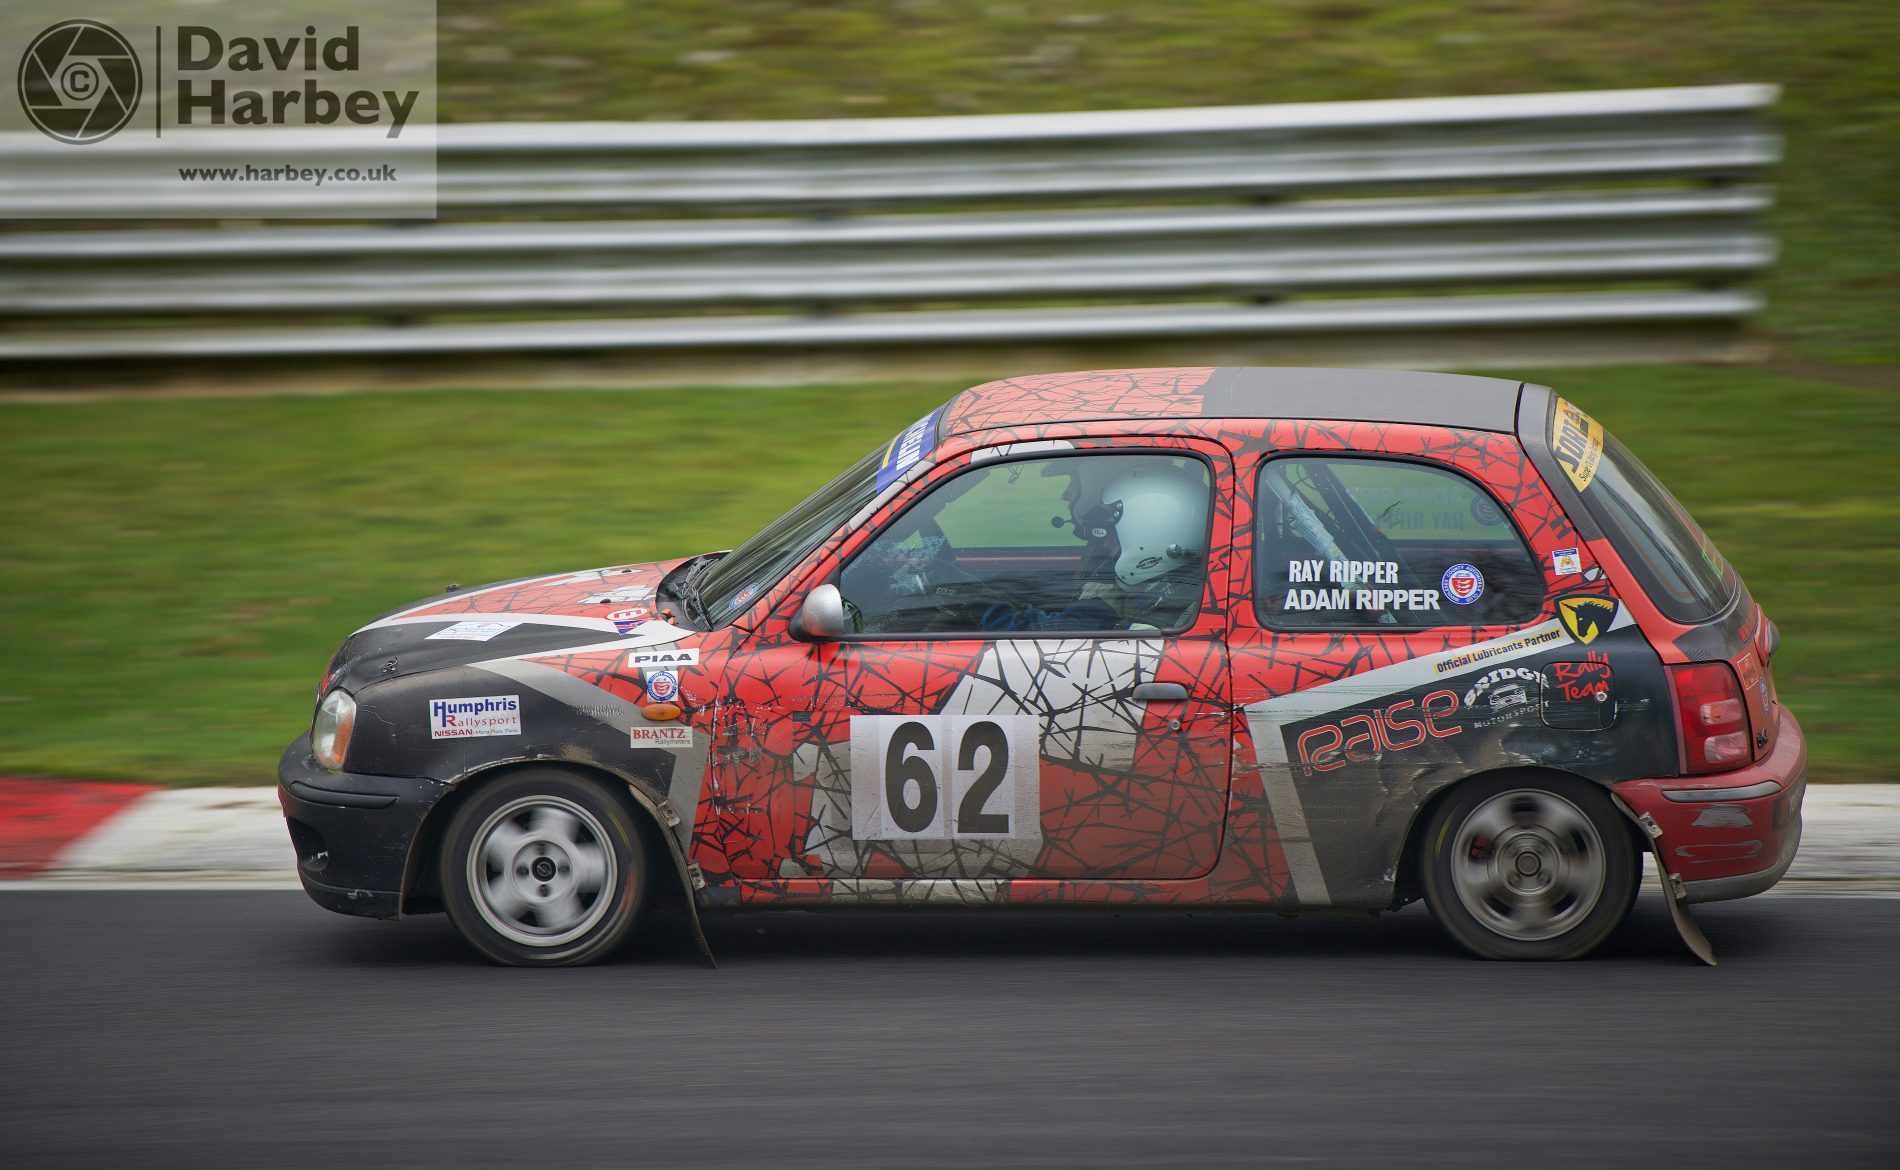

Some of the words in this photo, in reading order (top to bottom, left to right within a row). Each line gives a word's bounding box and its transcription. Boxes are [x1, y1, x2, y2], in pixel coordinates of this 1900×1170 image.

[1289, 560, 1324, 583] RAY
[1329, 560, 1399, 584] RIPPER
[1284, 589, 1350, 610] ADAM
[1356, 589, 1441, 610] RIPPER
[634, 653, 692, 664] PIAA
[1436, 653, 1472, 673] Official
[1472, 642, 1524, 666] Lubricants
[1524, 628, 1561, 648] Partner
[1553, 650, 1612, 682] Rally
[1556, 680, 1610, 703] Team
[433, 698, 517, 719] Humphris
[443, 714, 517, 728] Rallysport
[434, 729, 473, 737] NISSAN
[633, 728, 686, 740] BRANTZ
[655, 737, 691, 746] Rallymeters
[885, 721, 1009, 834] 62
